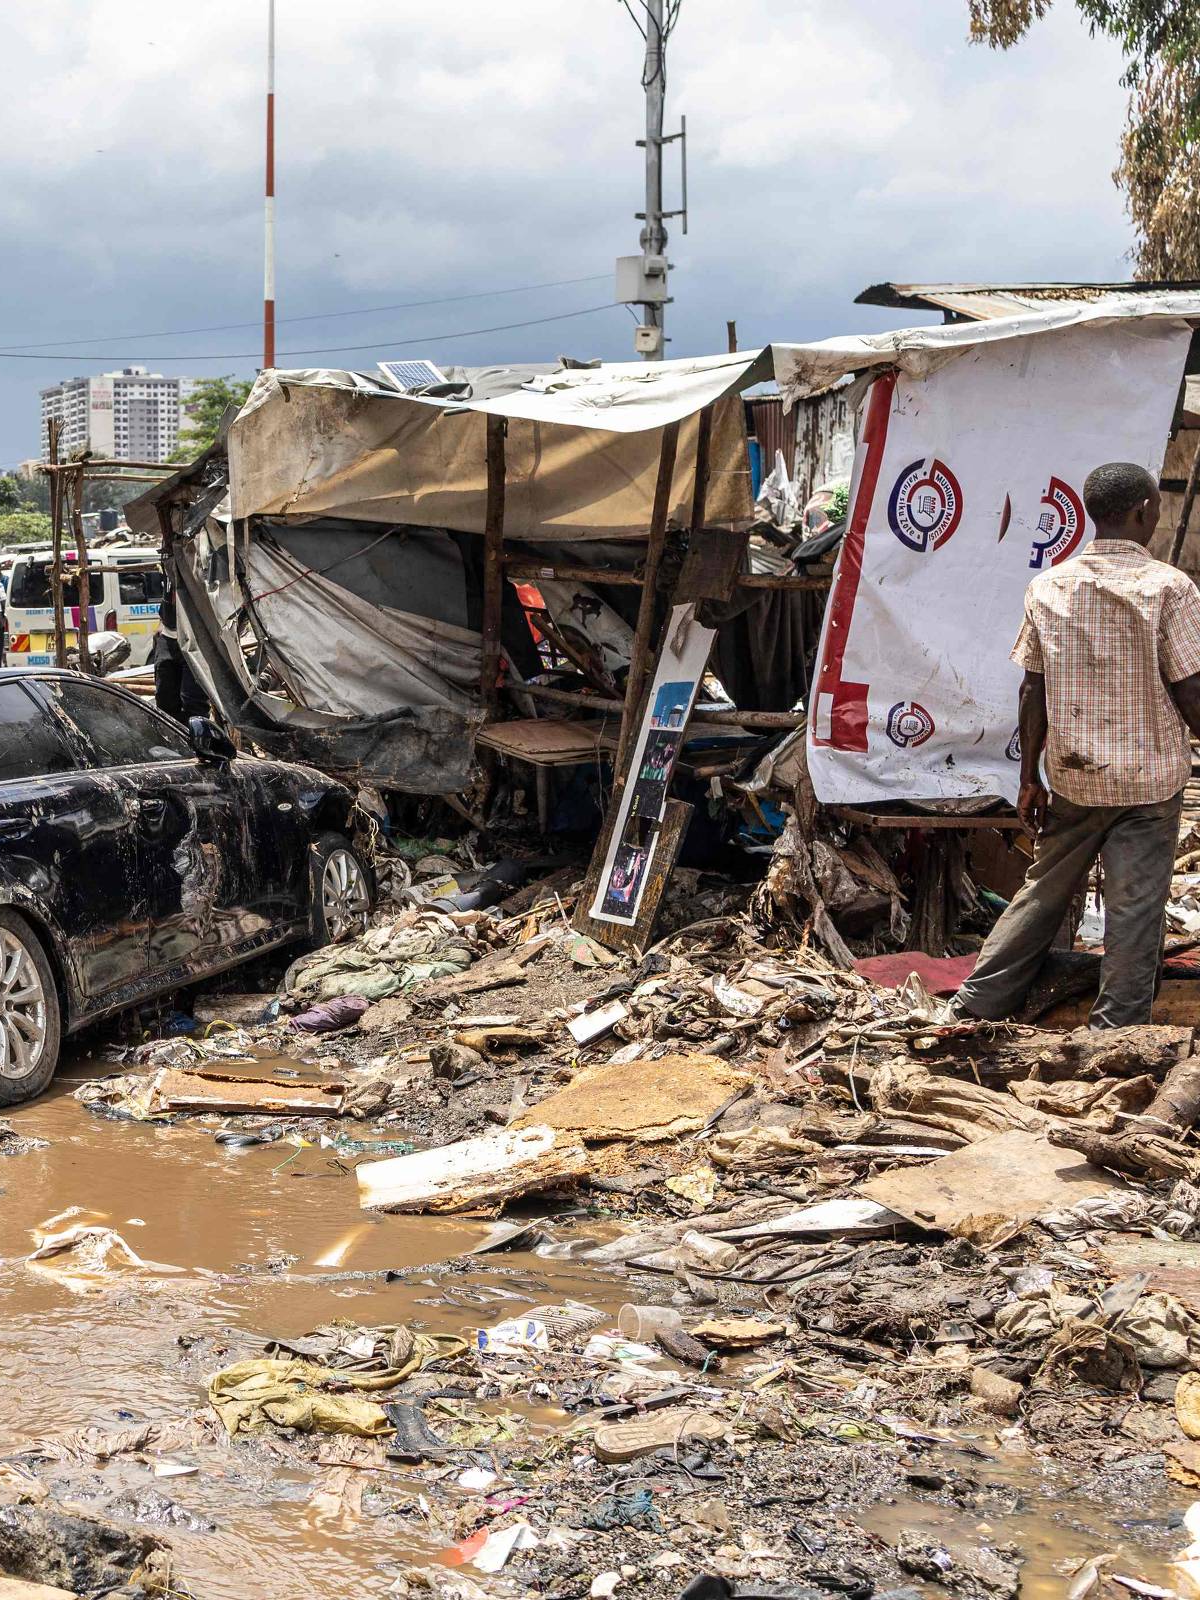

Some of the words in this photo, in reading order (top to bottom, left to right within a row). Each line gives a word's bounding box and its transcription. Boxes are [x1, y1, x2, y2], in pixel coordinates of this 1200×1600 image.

[935, 473, 954, 511] MUHINDI
[1054, 491, 1076, 528] MUHINDI
[928, 512, 953, 542] MWEUSI
[1044, 529, 1074, 558] MWEUSI
